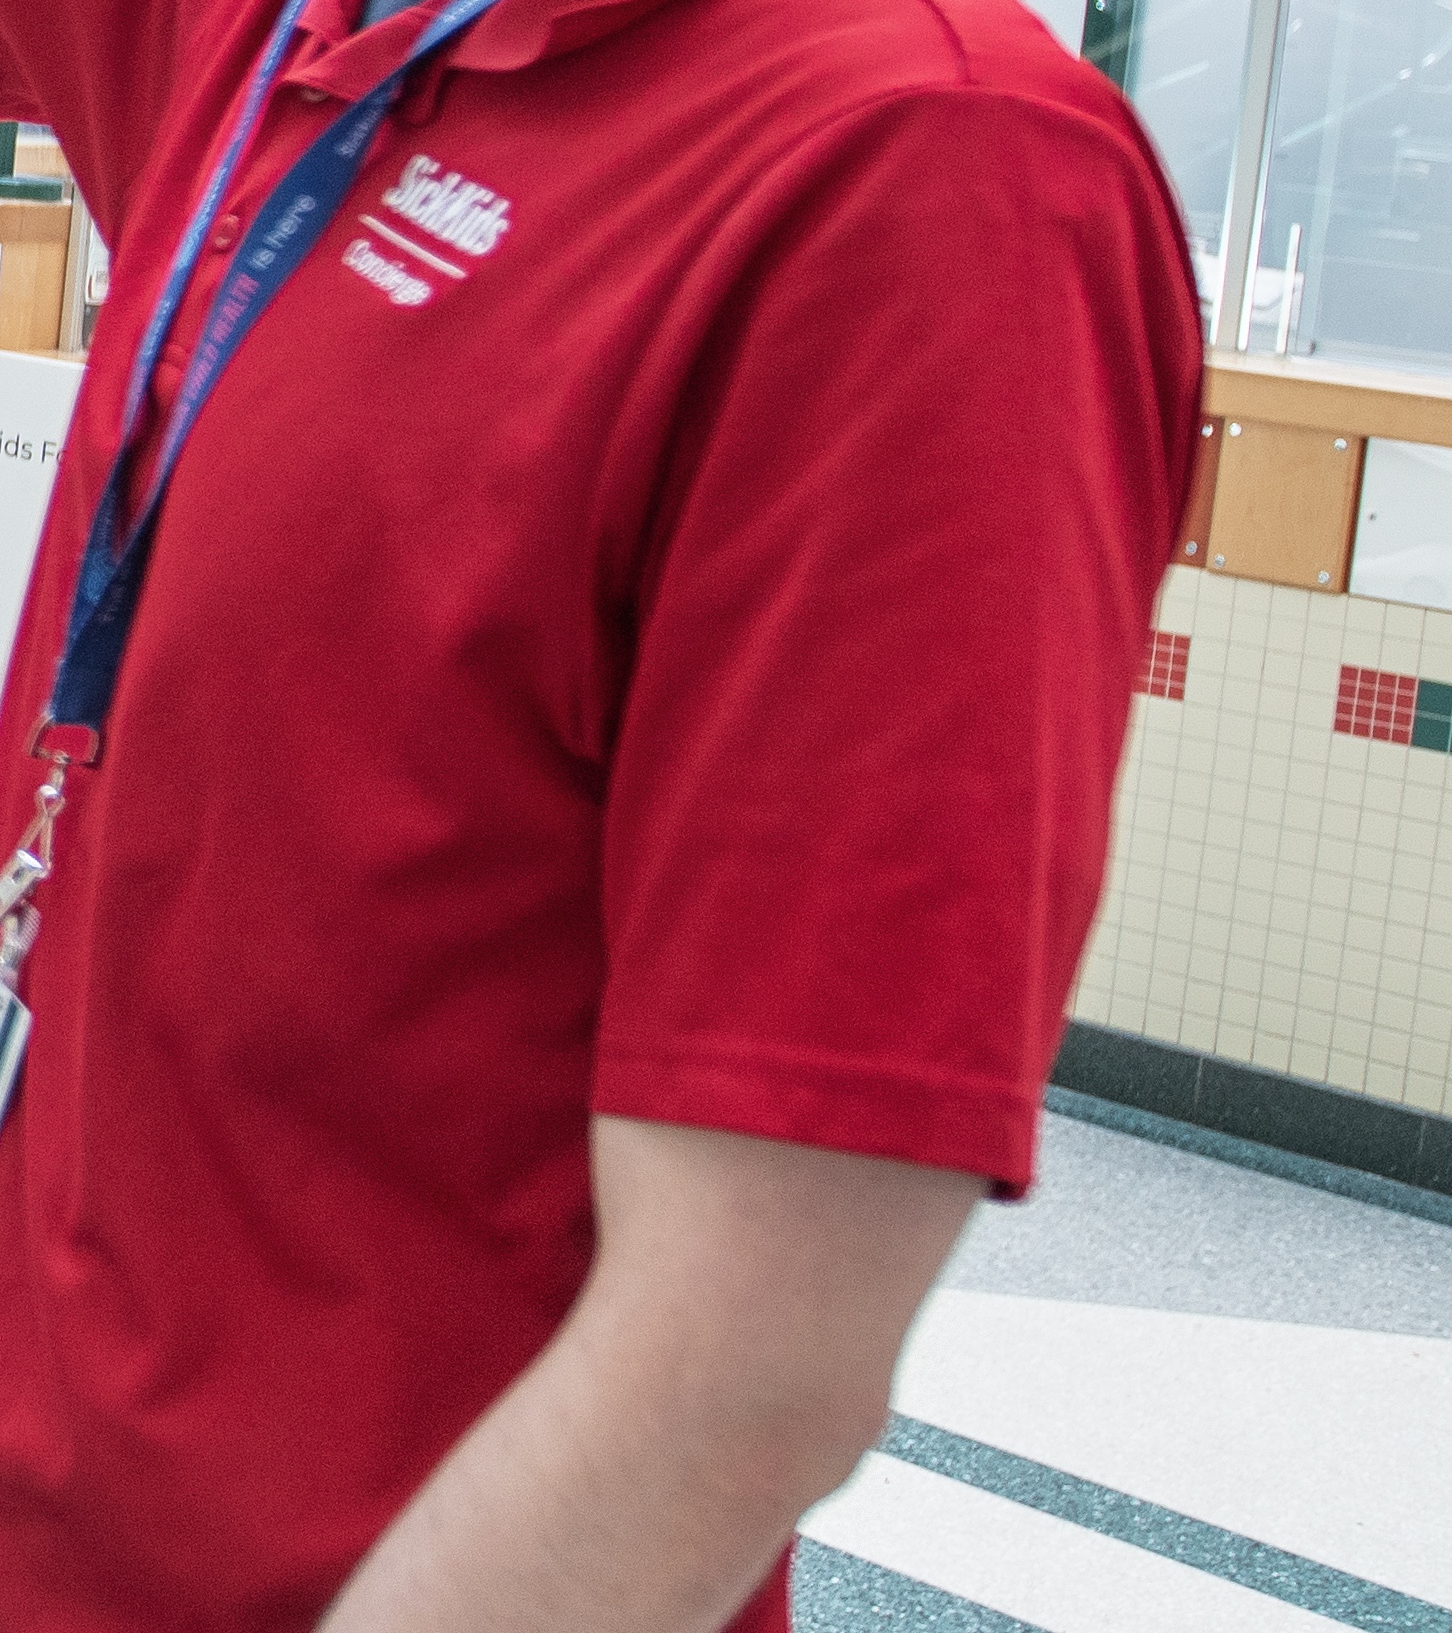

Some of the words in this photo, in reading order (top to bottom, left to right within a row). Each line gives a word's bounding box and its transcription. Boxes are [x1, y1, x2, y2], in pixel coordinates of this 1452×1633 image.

[263, 194, 317, 248] here
[381, 153, 511, 256] SickKids
[340, 238, 433, 306] Concierge
